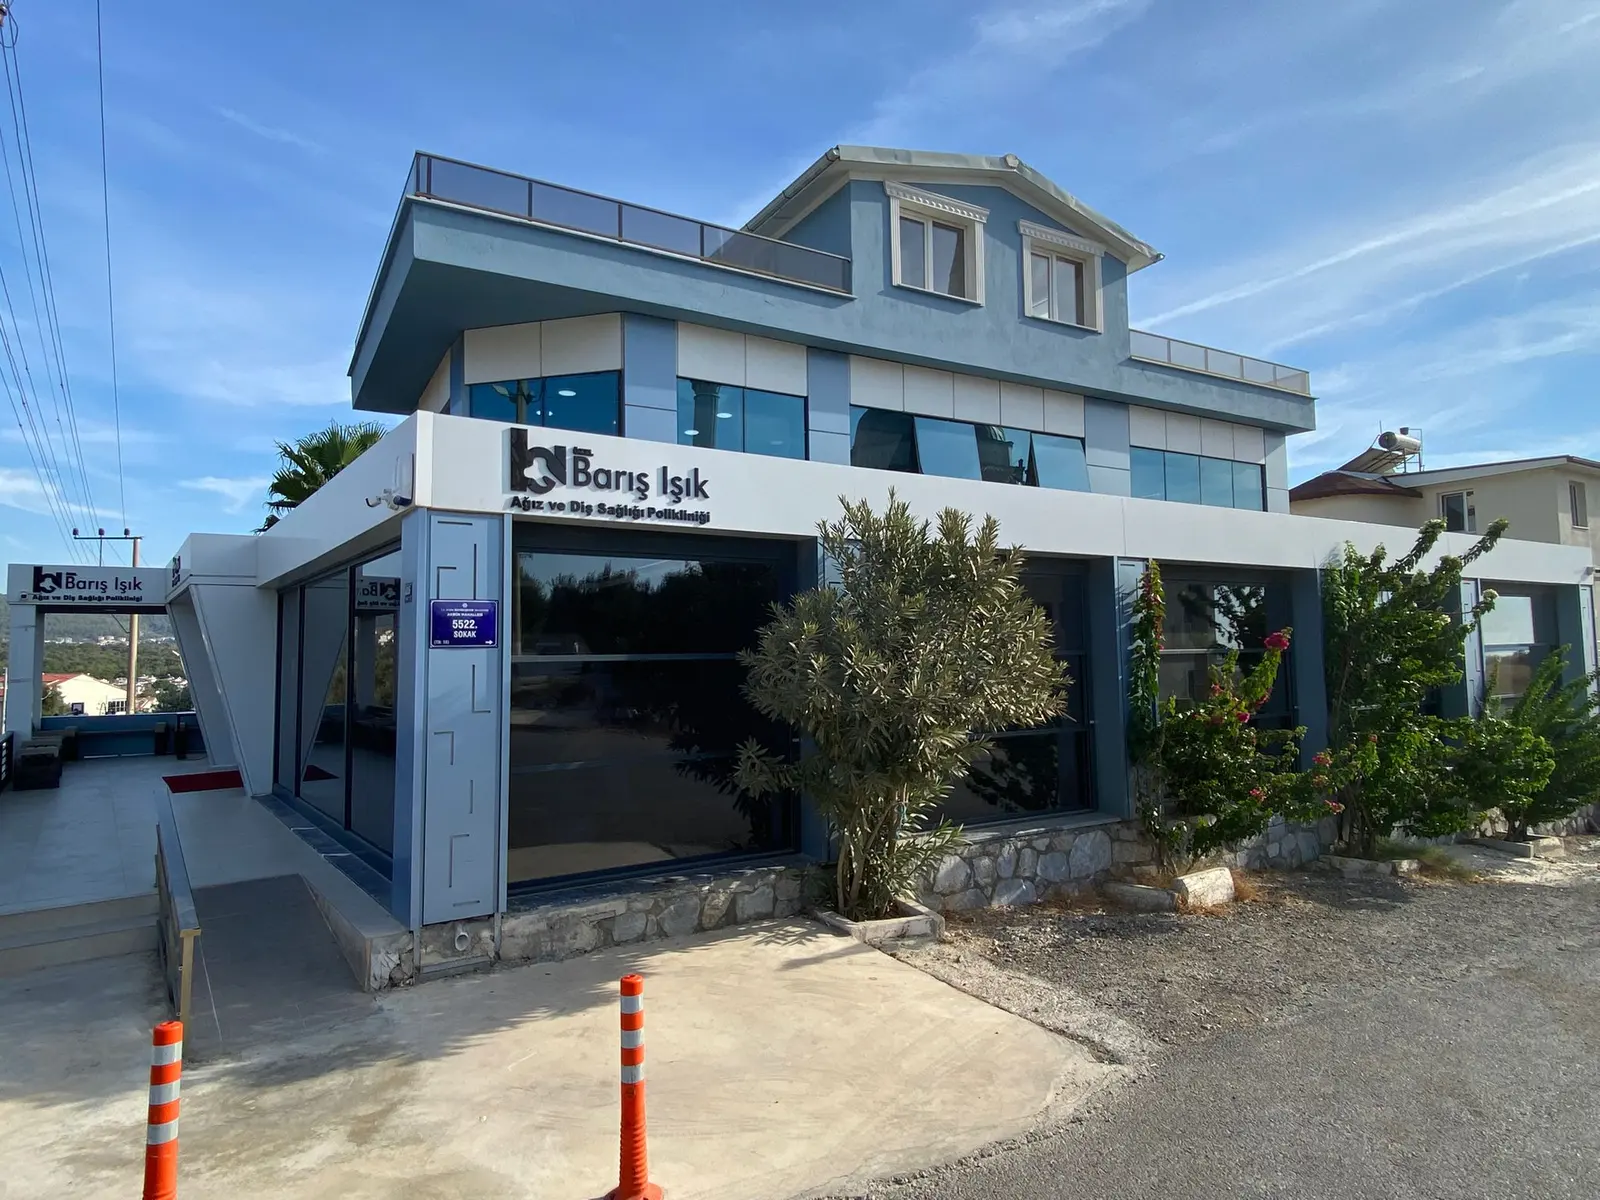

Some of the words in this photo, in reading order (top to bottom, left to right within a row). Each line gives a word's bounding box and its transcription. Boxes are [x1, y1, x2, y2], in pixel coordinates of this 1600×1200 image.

[573, 456, 650, 500] Barış
[662, 466, 710, 503] Işık
[510, 496, 544, 512] Ağız
[549, 502, 566, 511] ve
[570, 501, 593, 516] Diş
[597, 503, 645, 520] Sağlığı
[646, 509, 711, 524] Polikliniği
[65, 576, 108, 593] Barış
[114, 576, 143, 594] Işık
[452, 619, 478, 629] 5522.
[453, 630, 477, 638] SOKAK
